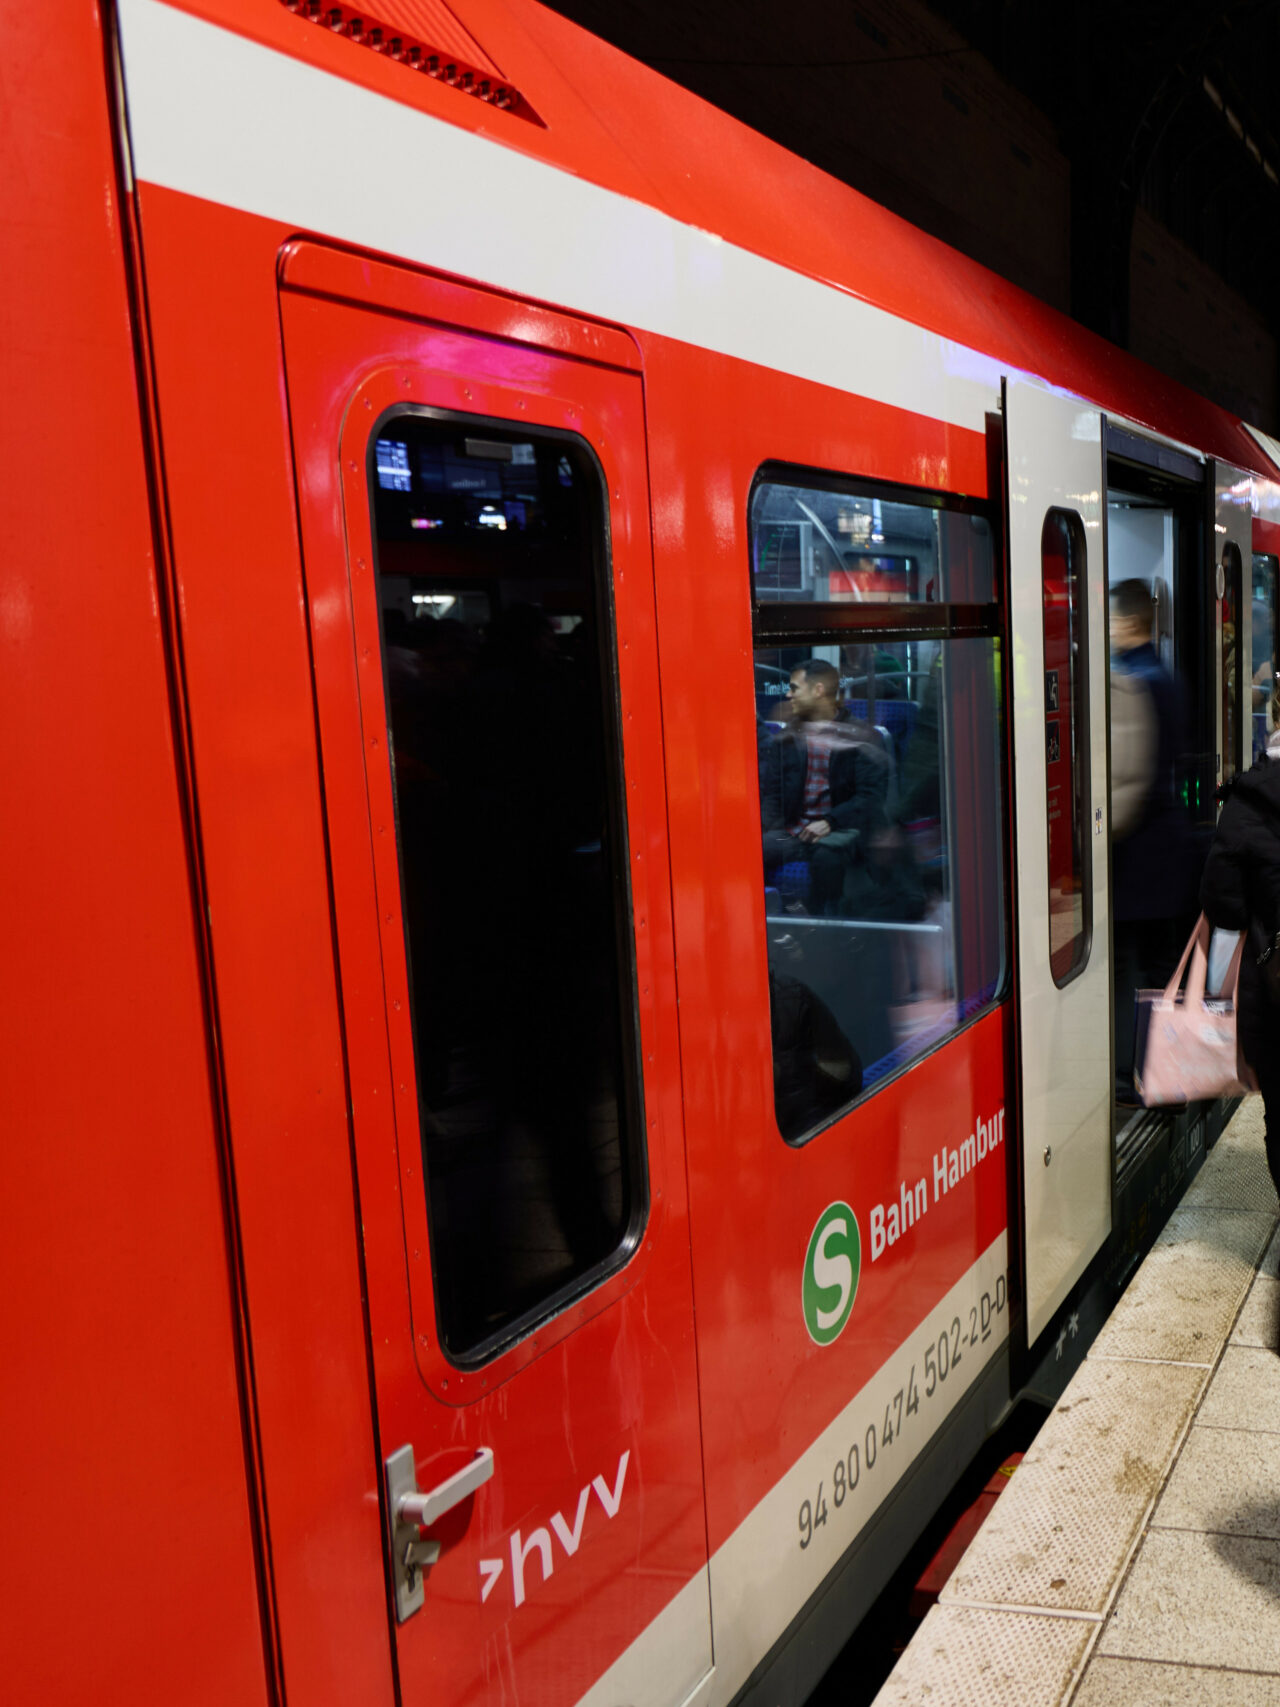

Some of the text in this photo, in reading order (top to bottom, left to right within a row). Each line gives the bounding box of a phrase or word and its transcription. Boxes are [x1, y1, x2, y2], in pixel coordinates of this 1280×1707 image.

[813, 1217, 853, 1331] S
[870, 1176, 928, 1263] Bahn
[799, 1480, 828, 1550] 94
[834, 1443, 860, 1508] 80
[882, 1364, 919, 1448] 474
